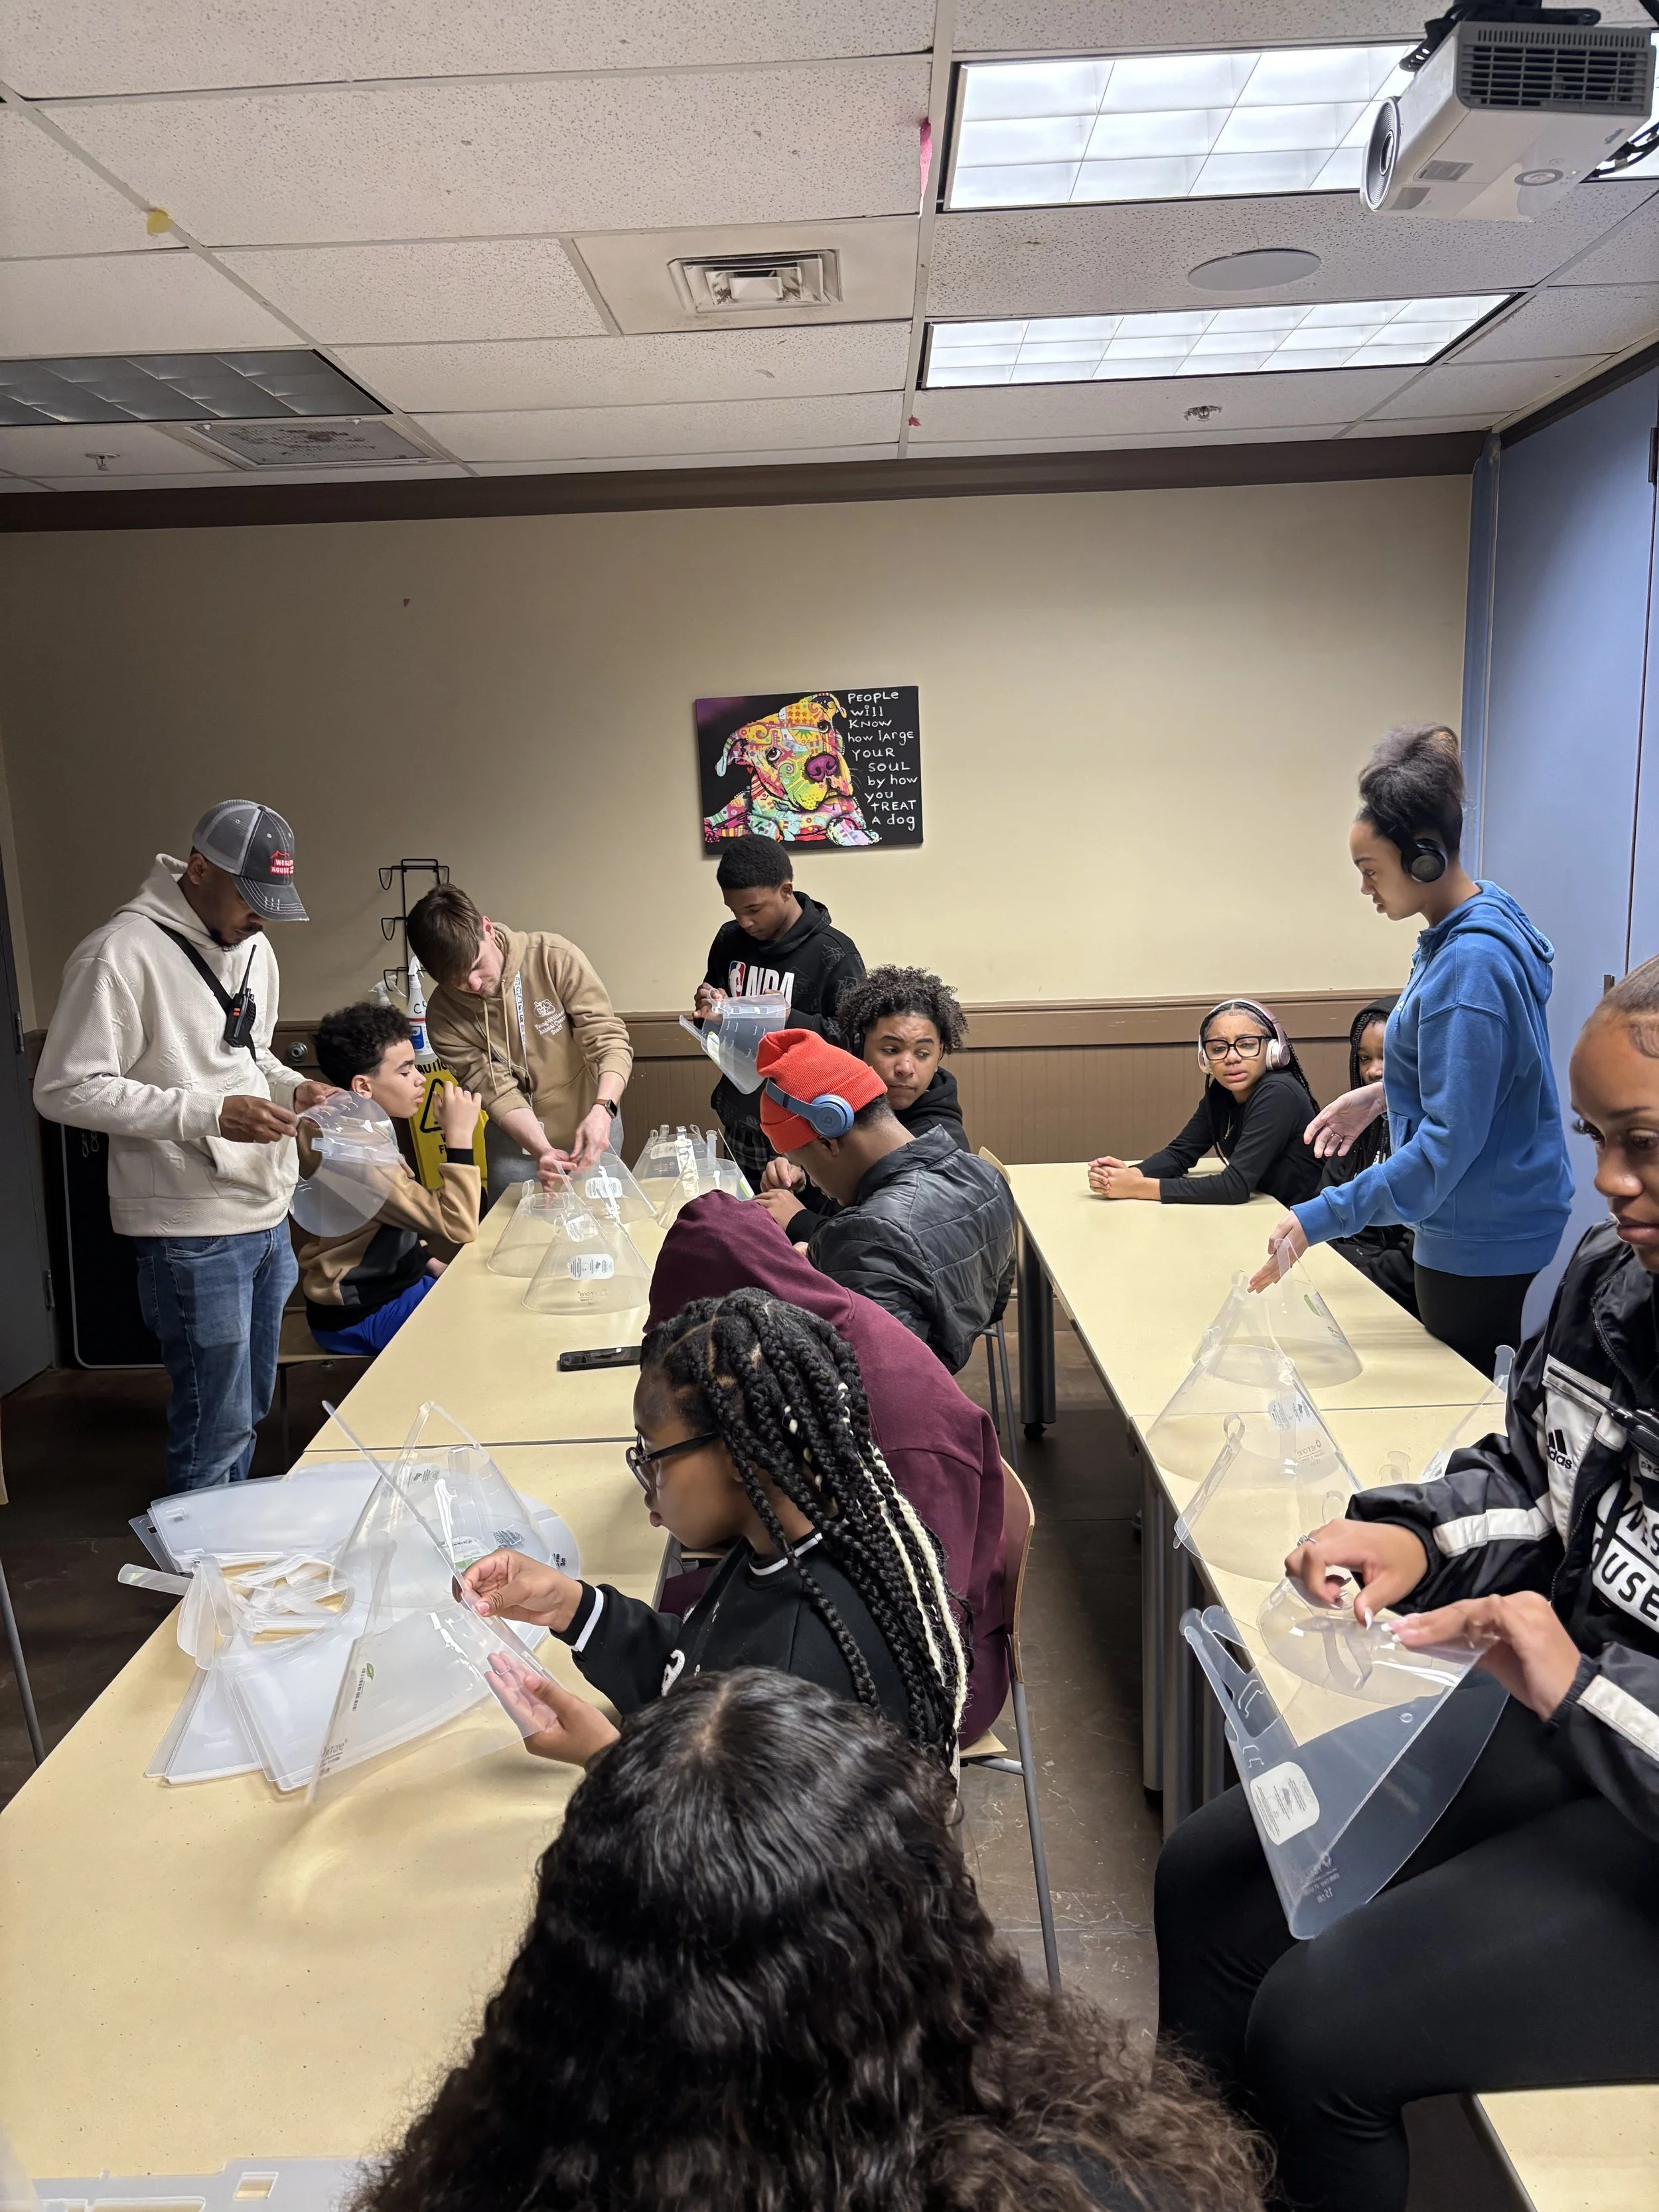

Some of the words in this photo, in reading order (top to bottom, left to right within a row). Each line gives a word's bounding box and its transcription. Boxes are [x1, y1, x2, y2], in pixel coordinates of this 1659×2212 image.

[850, 705, 883, 717] will
[847, 732, 873, 743] how
[867, 775, 886, 789] by
[890, 774, 918, 785] how
[864, 791, 893, 804] you
[887, 813, 915, 832] dog
